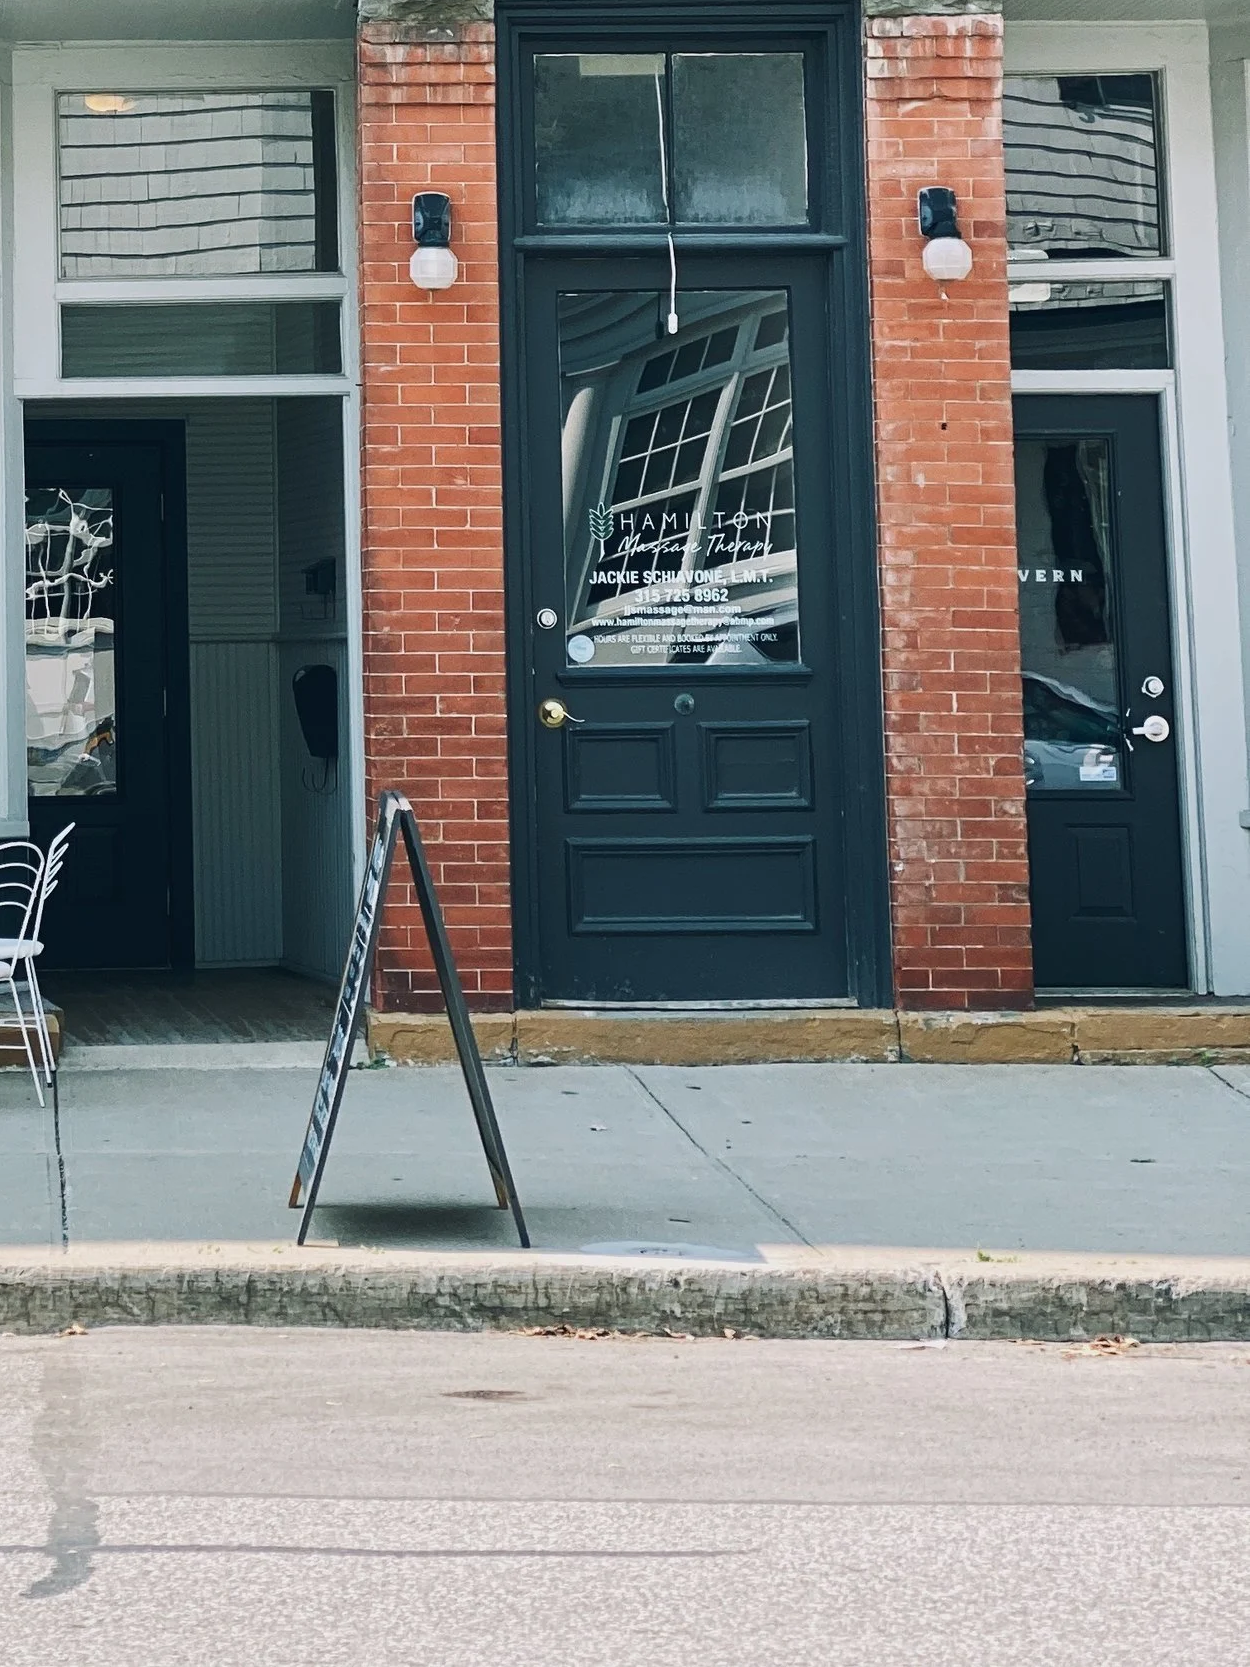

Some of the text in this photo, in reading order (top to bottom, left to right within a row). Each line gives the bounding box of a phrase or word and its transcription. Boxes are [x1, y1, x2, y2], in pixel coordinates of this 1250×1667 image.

[620, 512, 772, 530] HAMILTON
[706, 533, 773, 560] Therapy
[589, 569, 774, 585] JACKIE SCHIAVONE, L.M.T.
[634, 588, 729, 603] 315 725 8962
[594, 635, 617, 643] HOURS
[617, 635, 630, 643] ARE
